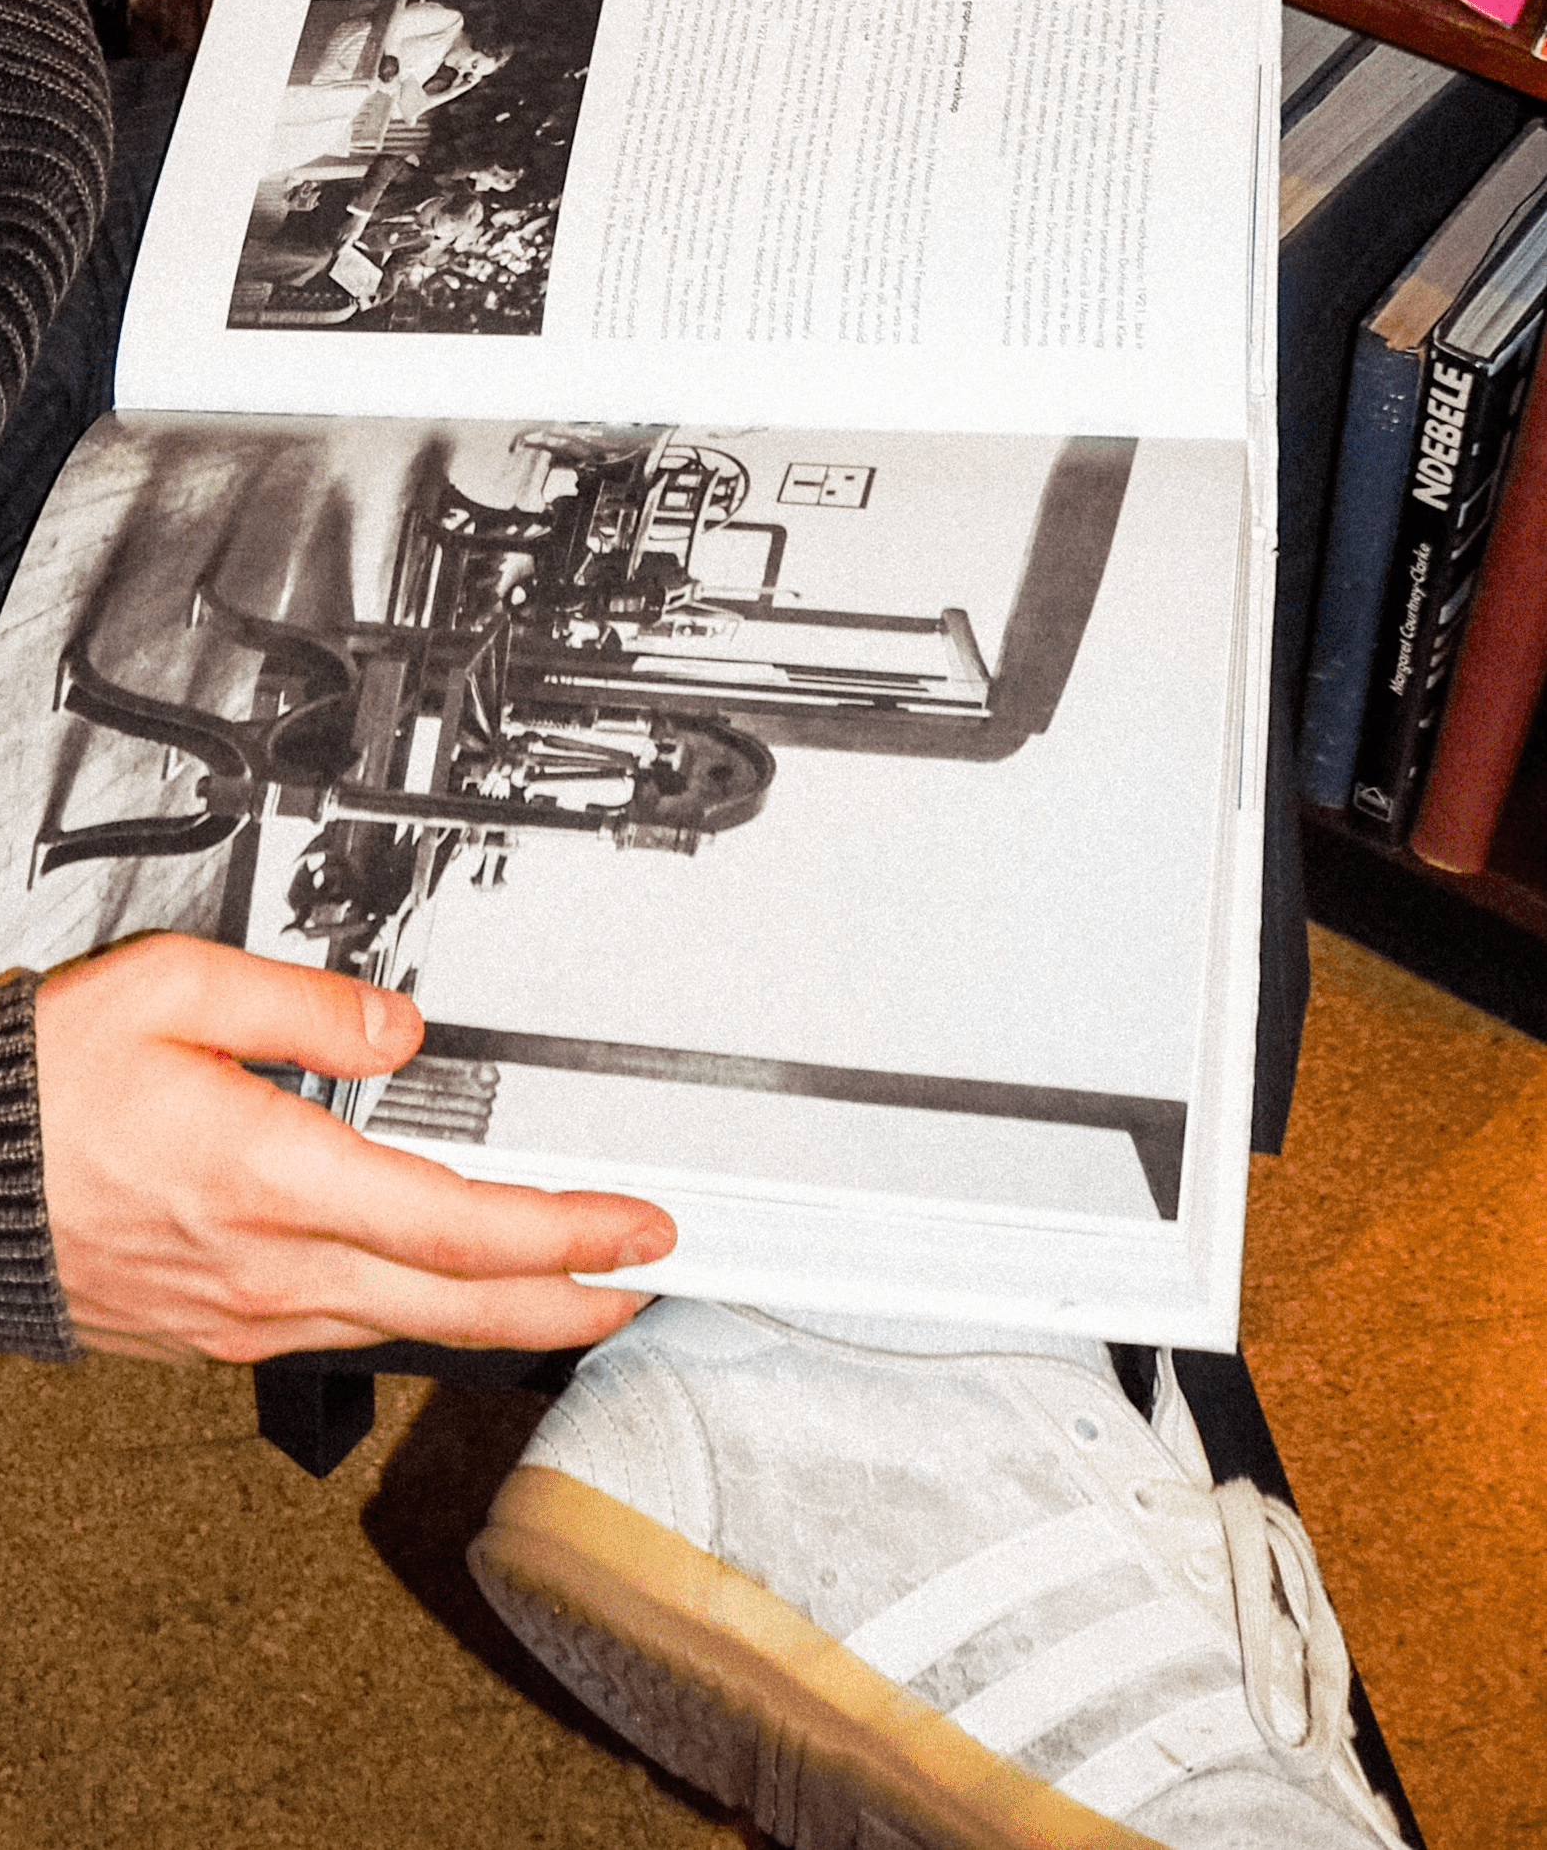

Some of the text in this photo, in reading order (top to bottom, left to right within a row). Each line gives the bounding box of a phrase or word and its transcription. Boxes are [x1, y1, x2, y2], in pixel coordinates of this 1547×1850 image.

[953, 33, 972, 70] printing
[947, 70, 966, 115] workshop
[1412, 361, 1475, 513] NDEBELE
[1388, 640, 1417, 699] Margaret
